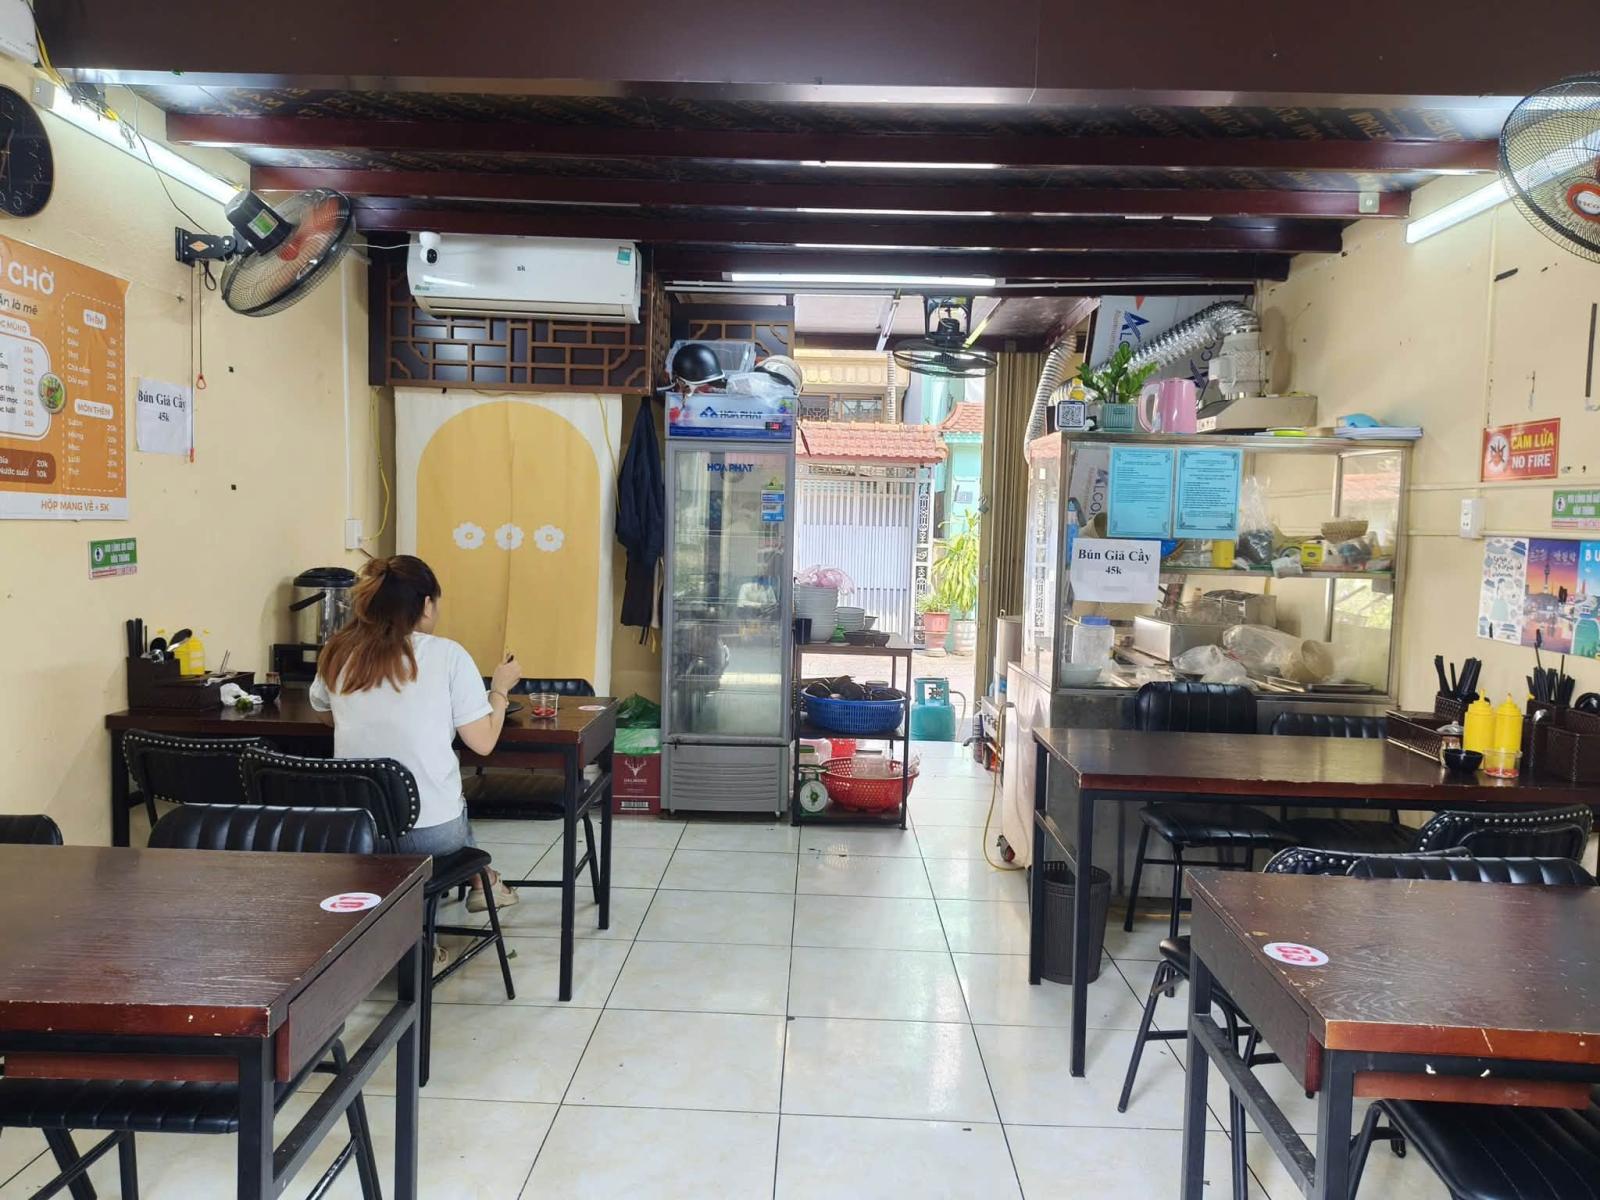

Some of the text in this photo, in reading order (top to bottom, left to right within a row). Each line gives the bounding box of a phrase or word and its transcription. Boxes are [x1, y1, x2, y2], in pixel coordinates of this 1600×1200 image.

[7, 260, 55, 295] CHỜ
[1512, 454, 1551, 469] NO FIRE
[60, 501, 83, 512] MANG
[1078, 548, 1101, 560] Bún
[1105, 565, 1122, 575] 45k
